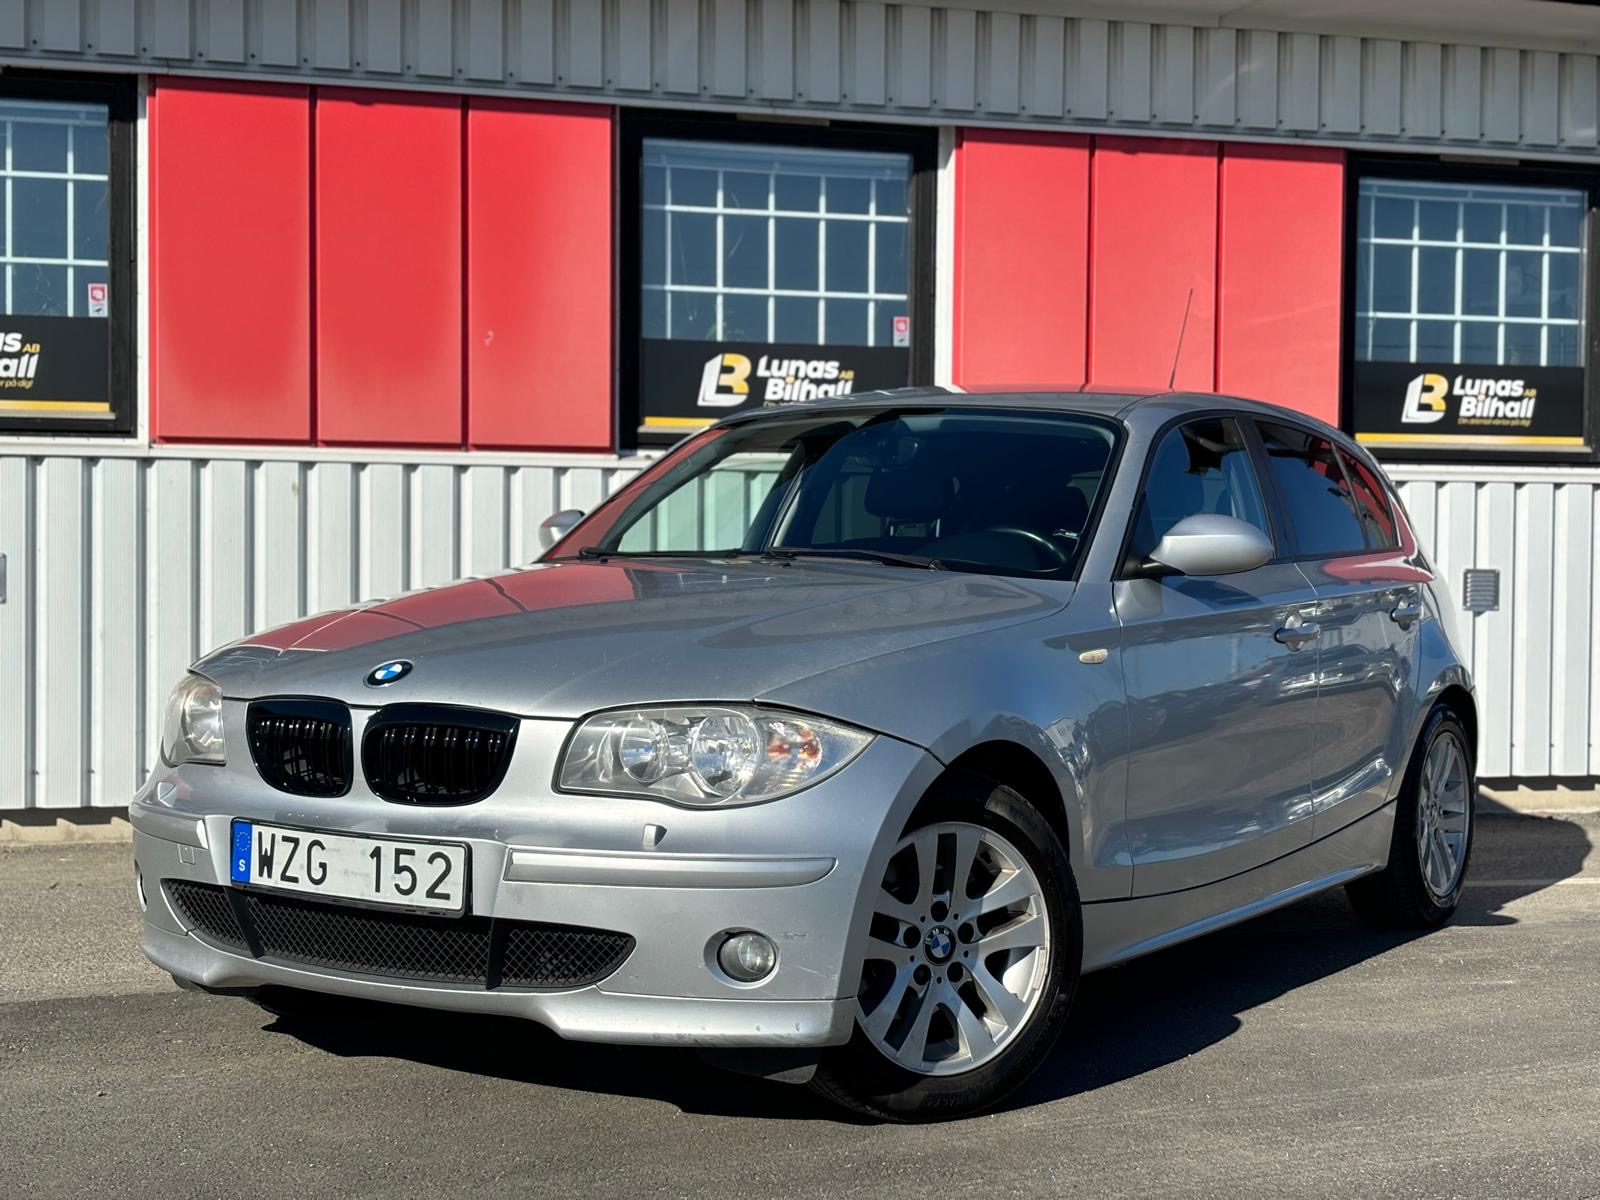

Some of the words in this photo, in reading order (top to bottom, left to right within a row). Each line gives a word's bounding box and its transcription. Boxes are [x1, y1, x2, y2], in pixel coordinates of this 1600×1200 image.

[22, 343, 41, 353] AB
[756, 354, 840, 379] Lunas
[839, 370, 855, 380] AB
[764, 375, 853, 401] Bilhall
[1452, 375, 1525, 397] Lunas
[1524, 388, 1537, 397] AB
[1459, 394, 1536, 418] Bilhall
[238, 860, 246, 872] S
[257, 831, 328, 886] WZG
[369, 846, 452, 901] 152
